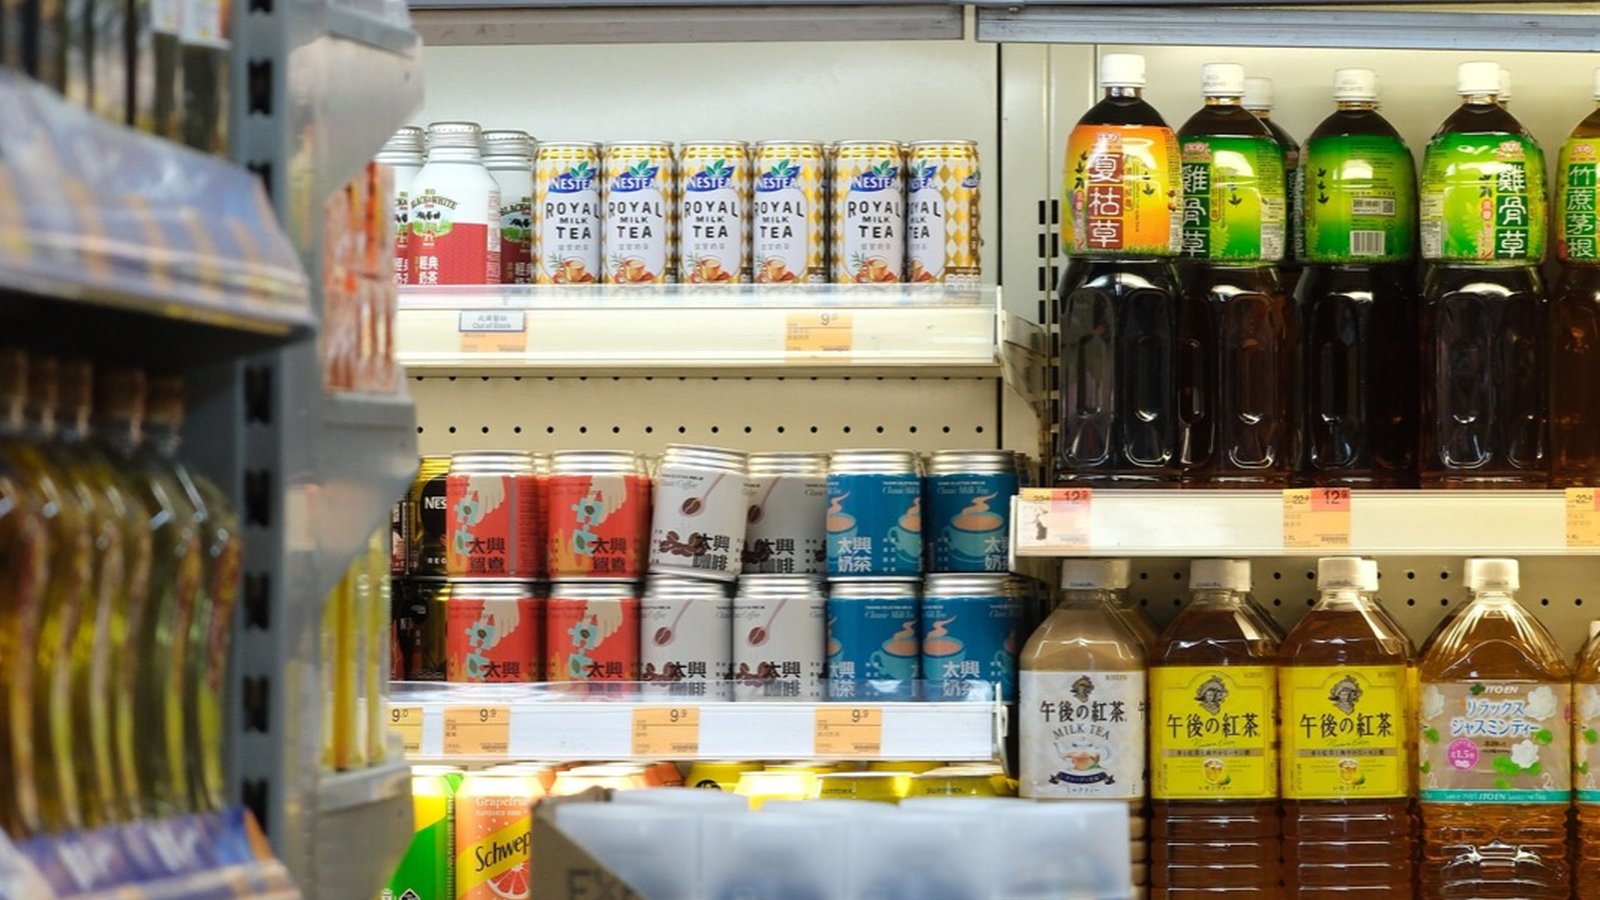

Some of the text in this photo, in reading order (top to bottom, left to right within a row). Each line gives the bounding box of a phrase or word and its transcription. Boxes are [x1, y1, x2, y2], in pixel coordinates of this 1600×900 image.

[1088, 153, 1122, 248] 夏枯草
[545, 202, 600, 219] ROYAL
[608, 202, 662, 218] ROYAL
[684, 201, 738, 218] ROYAL
[848, 201, 901, 218] ROYAL
[1567, 165, 1595, 258] 竹蔗茅根
[556, 226, 591, 239] TEA
[616, 226, 652, 239] TEA
[693, 225, 728, 238] TEA
[760, 225, 793, 238] TEA
[859, 226, 894, 239] TEA
[468, 537, 505, 554] 太興
[591, 537, 627, 554] 太興
[697, 532, 731, 553] 太興
[761, 537, 796, 556] 太興
[838, 536, 872, 554] 太興
[837, 554, 872, 573] 奶茶
[483, 661, 520, 678] 太興
[587, 661, 623, 678] 太興
[671, 661, 707, 679] 太興
[766, 661, 801, 679] 太興
[943, 661, 981, 679] 太興
[1040, 700, 1125, 722] 午後の紅茶
[1466, 701, 1525, 716] リラックス
[1052, 724, 1110, 740] MILK TEA
[1167, 713, 1259, 738] 午後の紅茶
[1300, 713, 1393, 738] 午後の紅茶
[1451, 720, 1540, 736] ジャスミンティー
